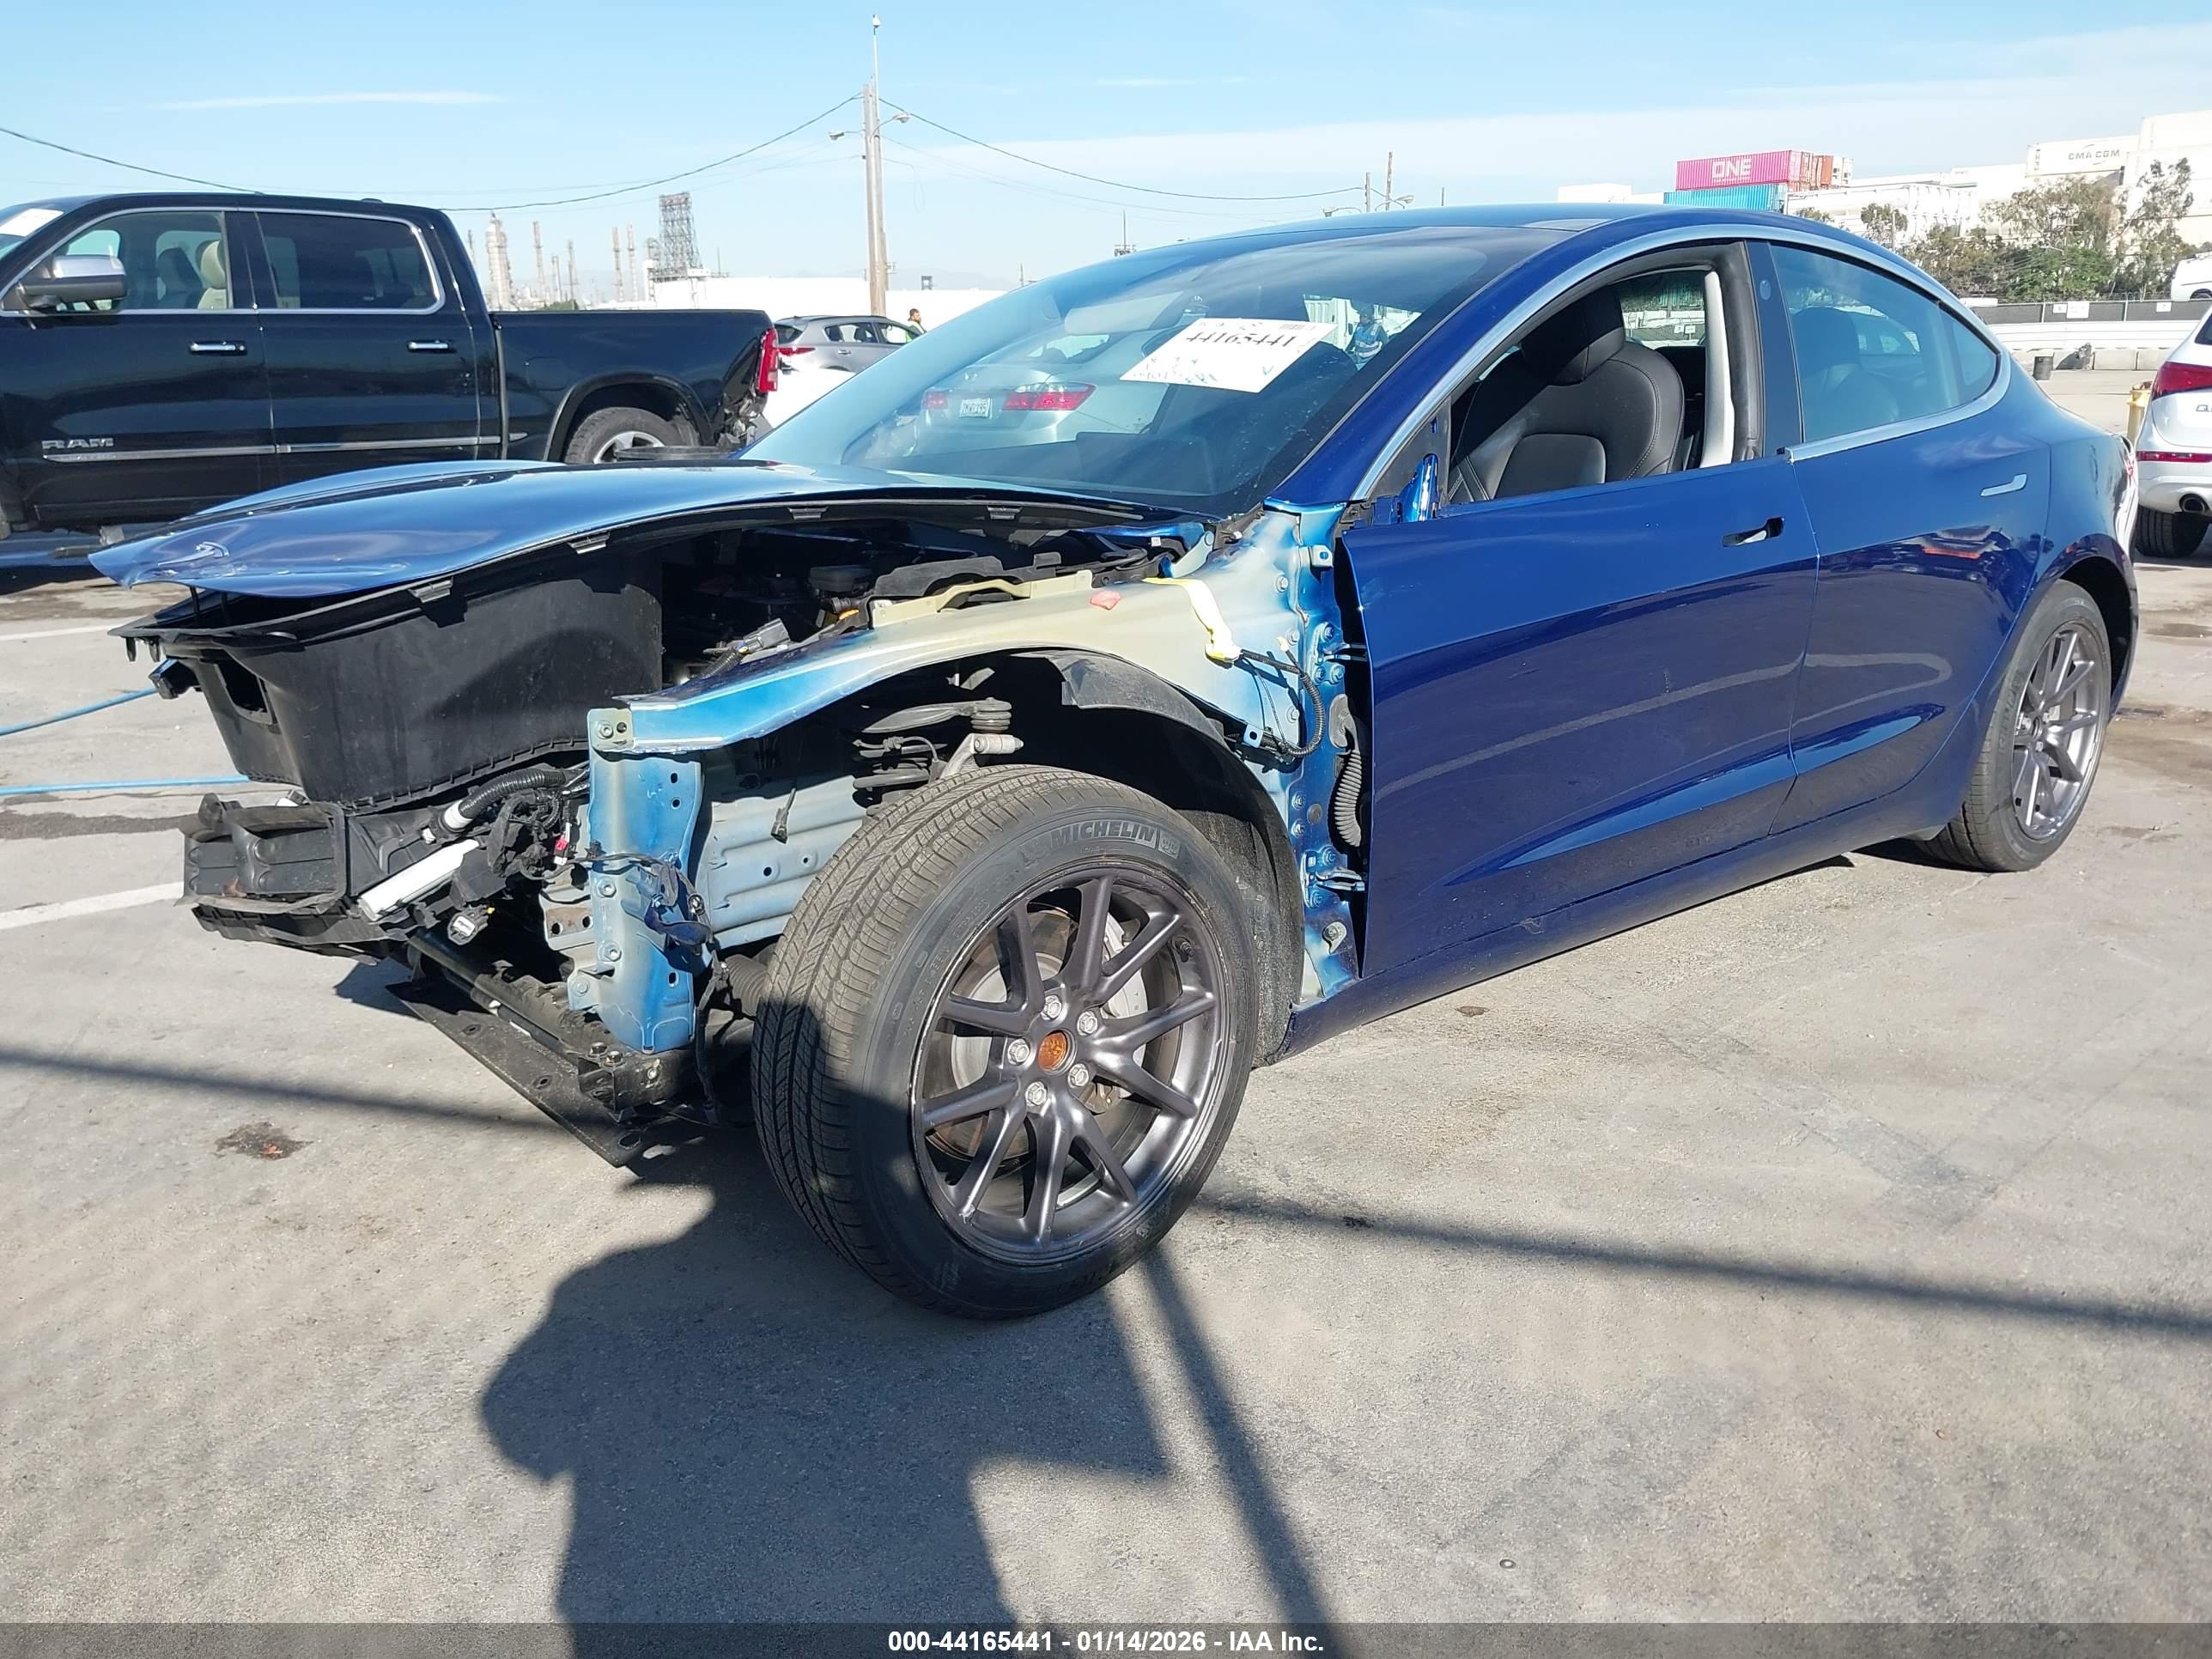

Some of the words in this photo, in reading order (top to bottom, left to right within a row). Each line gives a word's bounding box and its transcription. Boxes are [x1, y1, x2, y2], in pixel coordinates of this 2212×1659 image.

[2068, 152, 2093, 161] CMA
[2095, 149, 2120, 158] CGM
[1711, 158, 1752, 179] ONE
[2196, 404, 2212, 413] Q
[41, 437, 114, 449] RAM
[1050, 821, 1156, 848] MICHELIN
